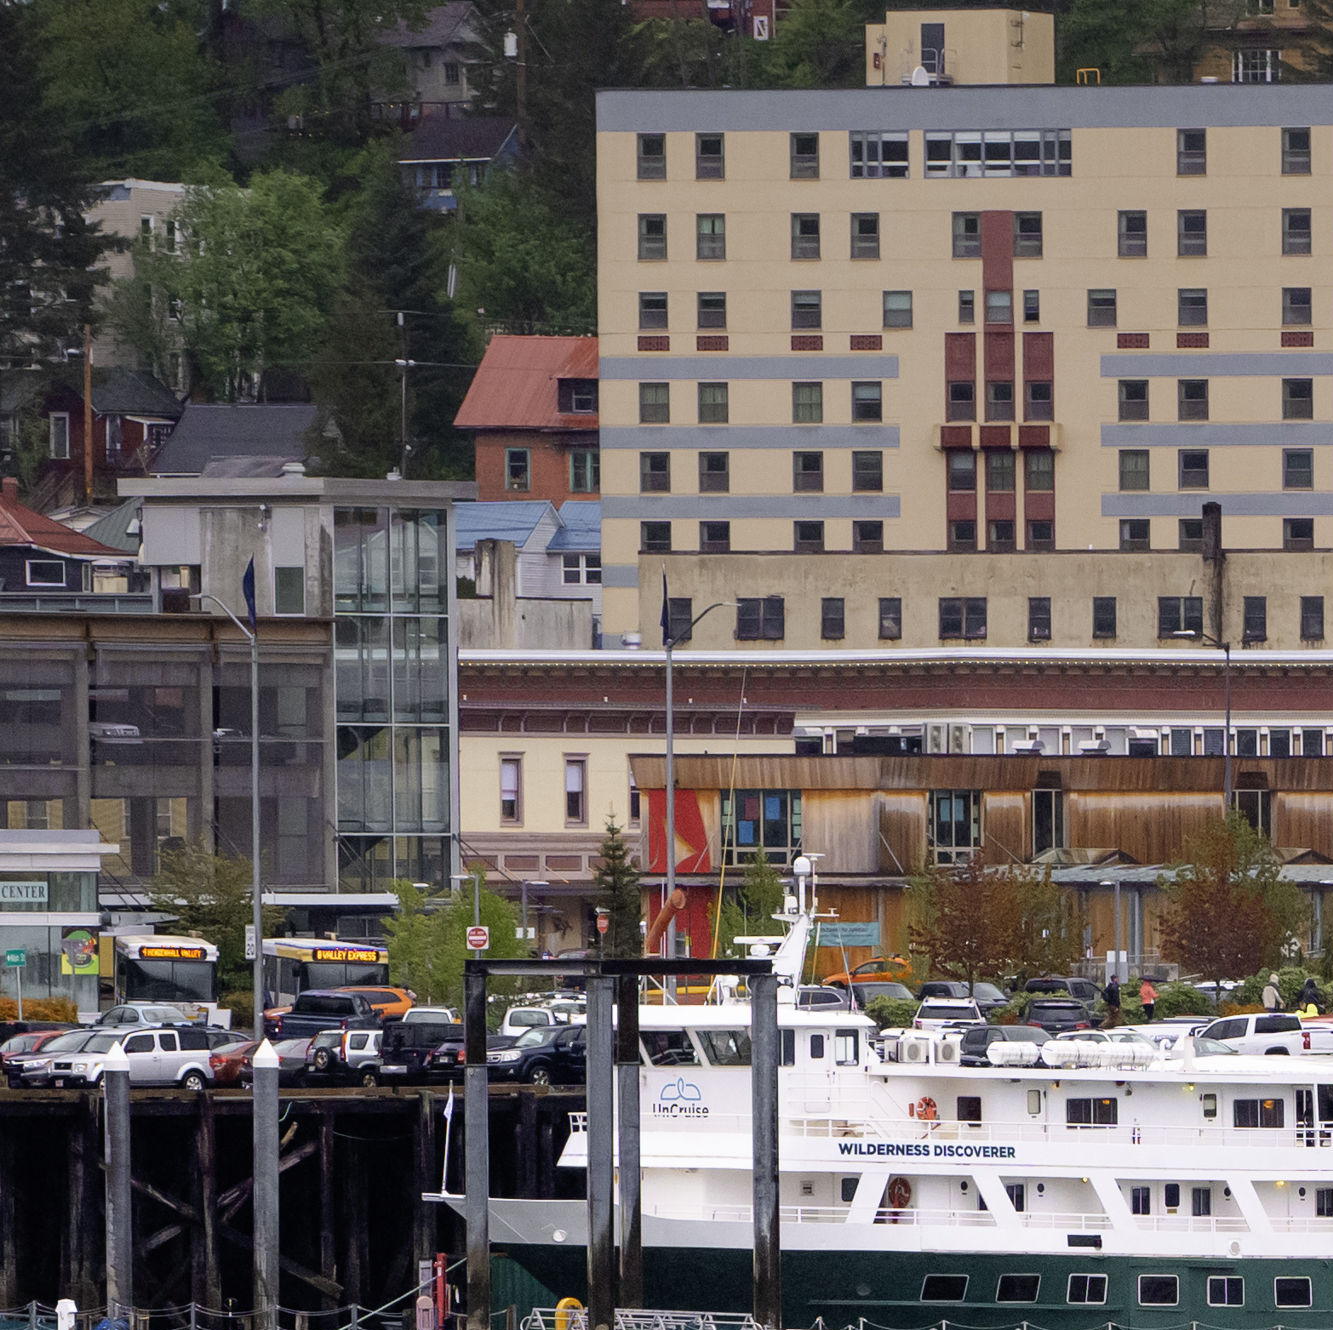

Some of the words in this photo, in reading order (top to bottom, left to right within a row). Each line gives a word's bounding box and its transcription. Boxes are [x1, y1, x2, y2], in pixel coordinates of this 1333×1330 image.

[1, 885, 45, 899] CENTER
[322, 951, 346, 960] VALLEY
[348, 951, 376, 961] EXPRESS
[652, 1103, 709, 1118] UnCruise
[838, 1143, 930, 1157] WILDERNESS
[933, 1145, 1016, 1159] DISCOVERER
